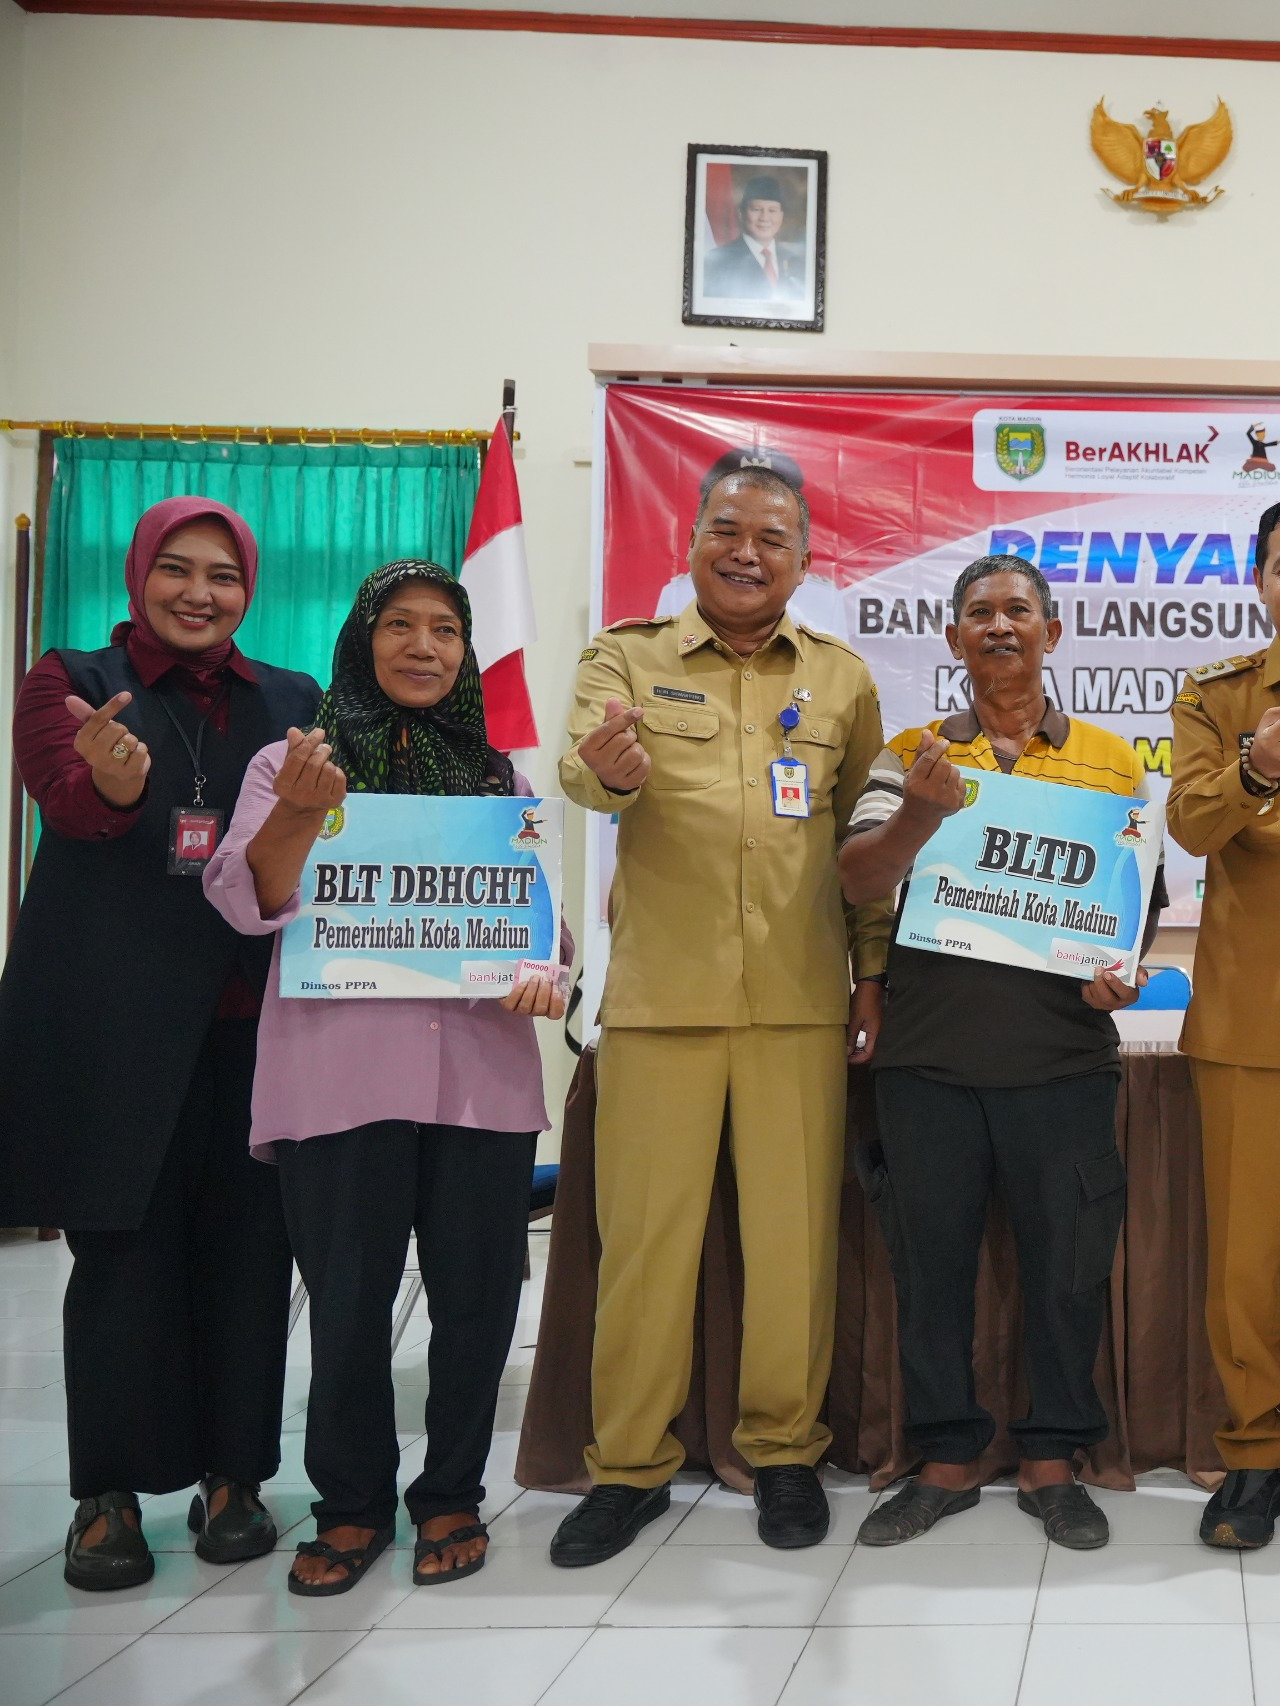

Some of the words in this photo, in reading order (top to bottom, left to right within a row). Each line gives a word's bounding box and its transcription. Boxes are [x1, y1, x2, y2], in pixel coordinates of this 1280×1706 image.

[1065, 440, 1211, 464] BerAKHLAK
[1076, 600, 1275, 640] LANGSUN
[511, 837, 548, 845] MADIUN
[1115, 833, 1147, 845] MADIUN
[976, 826, 1098, 888] BLTD
[313, 863, 382, 906] BLT
[389, 865, 535, 908] DBHCHT
[933, 876, 1018, 919] Pemerintah
[1022, 892, 1058, 927] Kota
[1060, 899, 1118, 937] Madiun
[313, 917, 415, 949] Pemerintah
[420, 917, 461, 949] Kota
[466, 918, 530, 949] Madiun
[908, 932, 942, 946] Dinsos
[945, 938, 972, 951] PPPA
[523, 961, 549, 972] 100000
[1056, 949, 1109, 968] bankjatim
[300, 981, 341, 990] Dinsos
[345, 981, 378, 990] PPPA
[469, 972, 514, 984] bankjat
